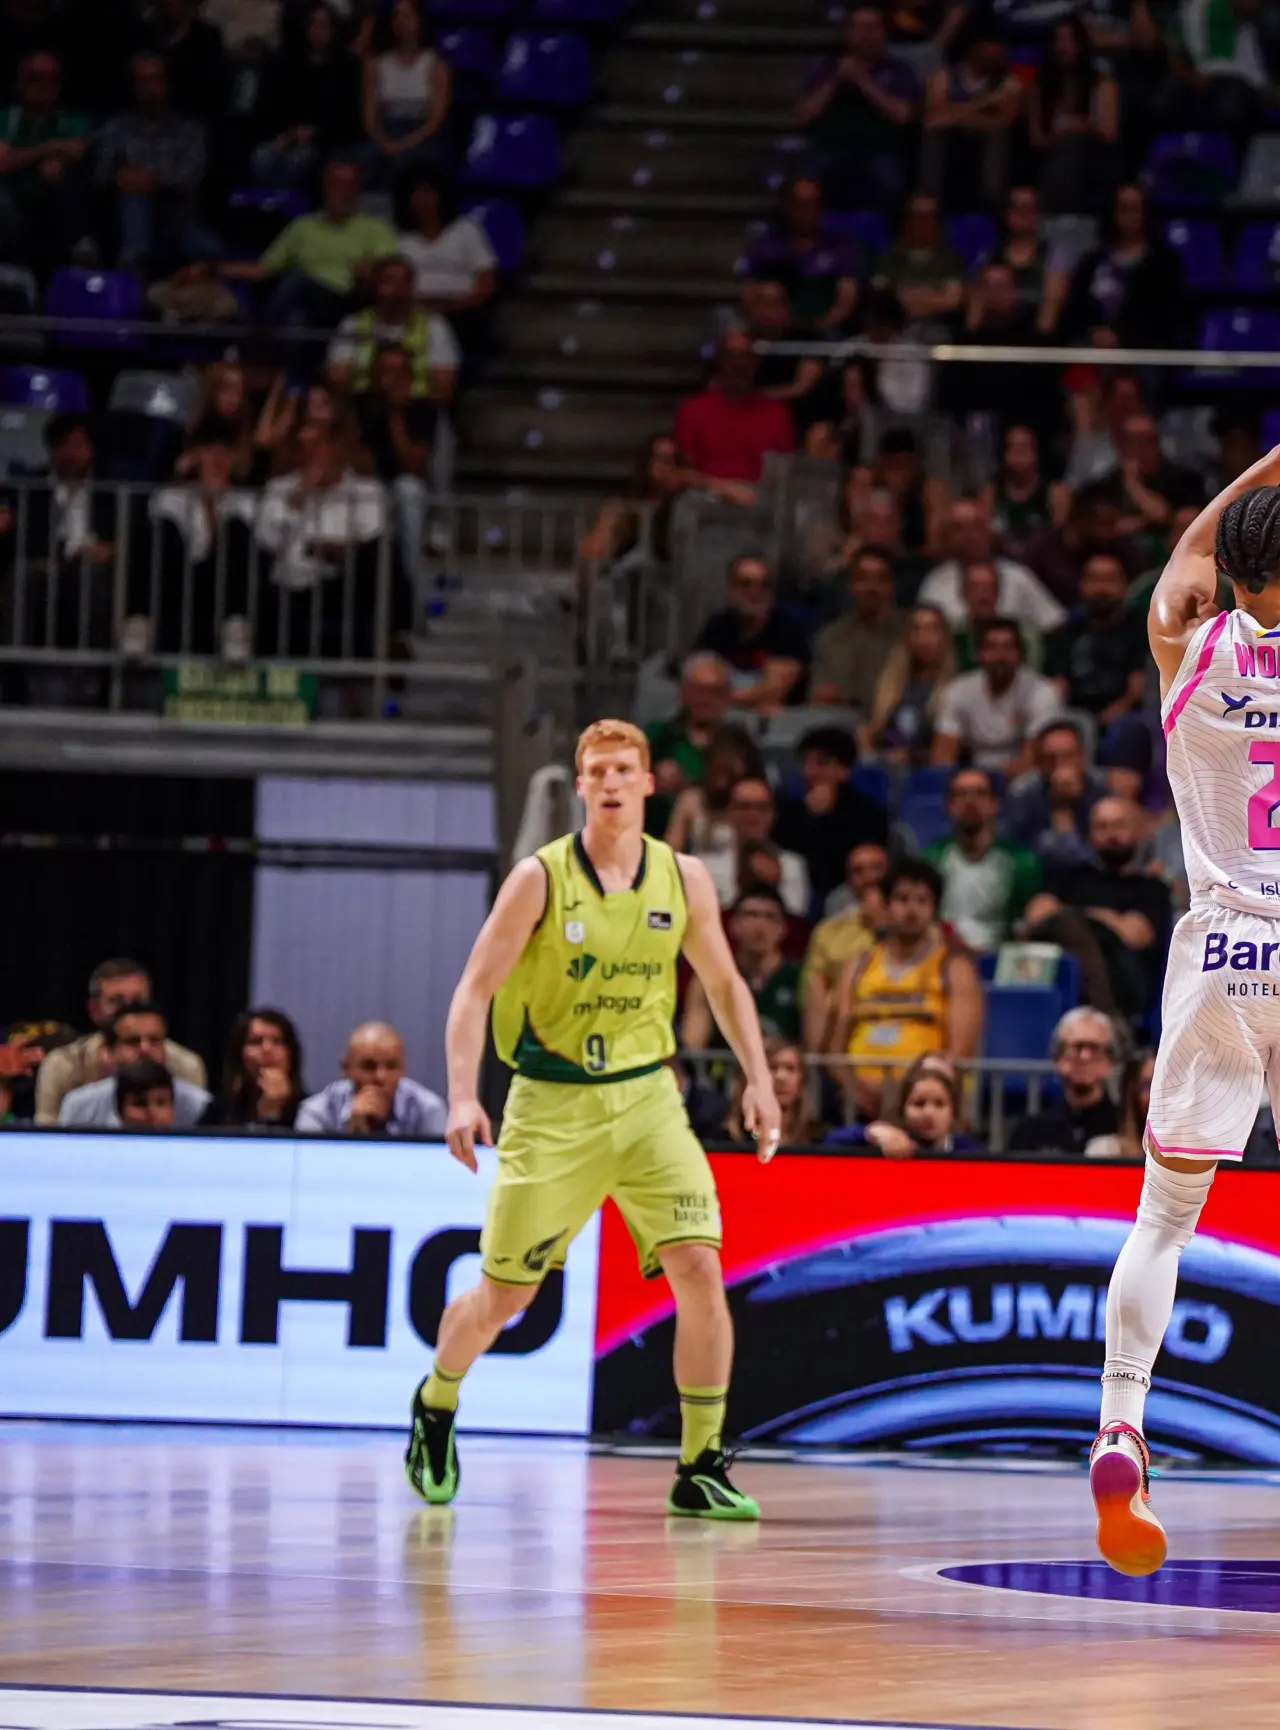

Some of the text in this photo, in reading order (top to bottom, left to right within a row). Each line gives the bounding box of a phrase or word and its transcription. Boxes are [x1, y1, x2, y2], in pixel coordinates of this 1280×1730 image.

[573, 995, 641, 1014] mlaga
[1227, 983, 1279, 996] HOTEL
[587, 1032, 605, 1072] 9
[0, 1215, 565, 1356] MHO
[883, 1281, 1234, 1365] KUMO
